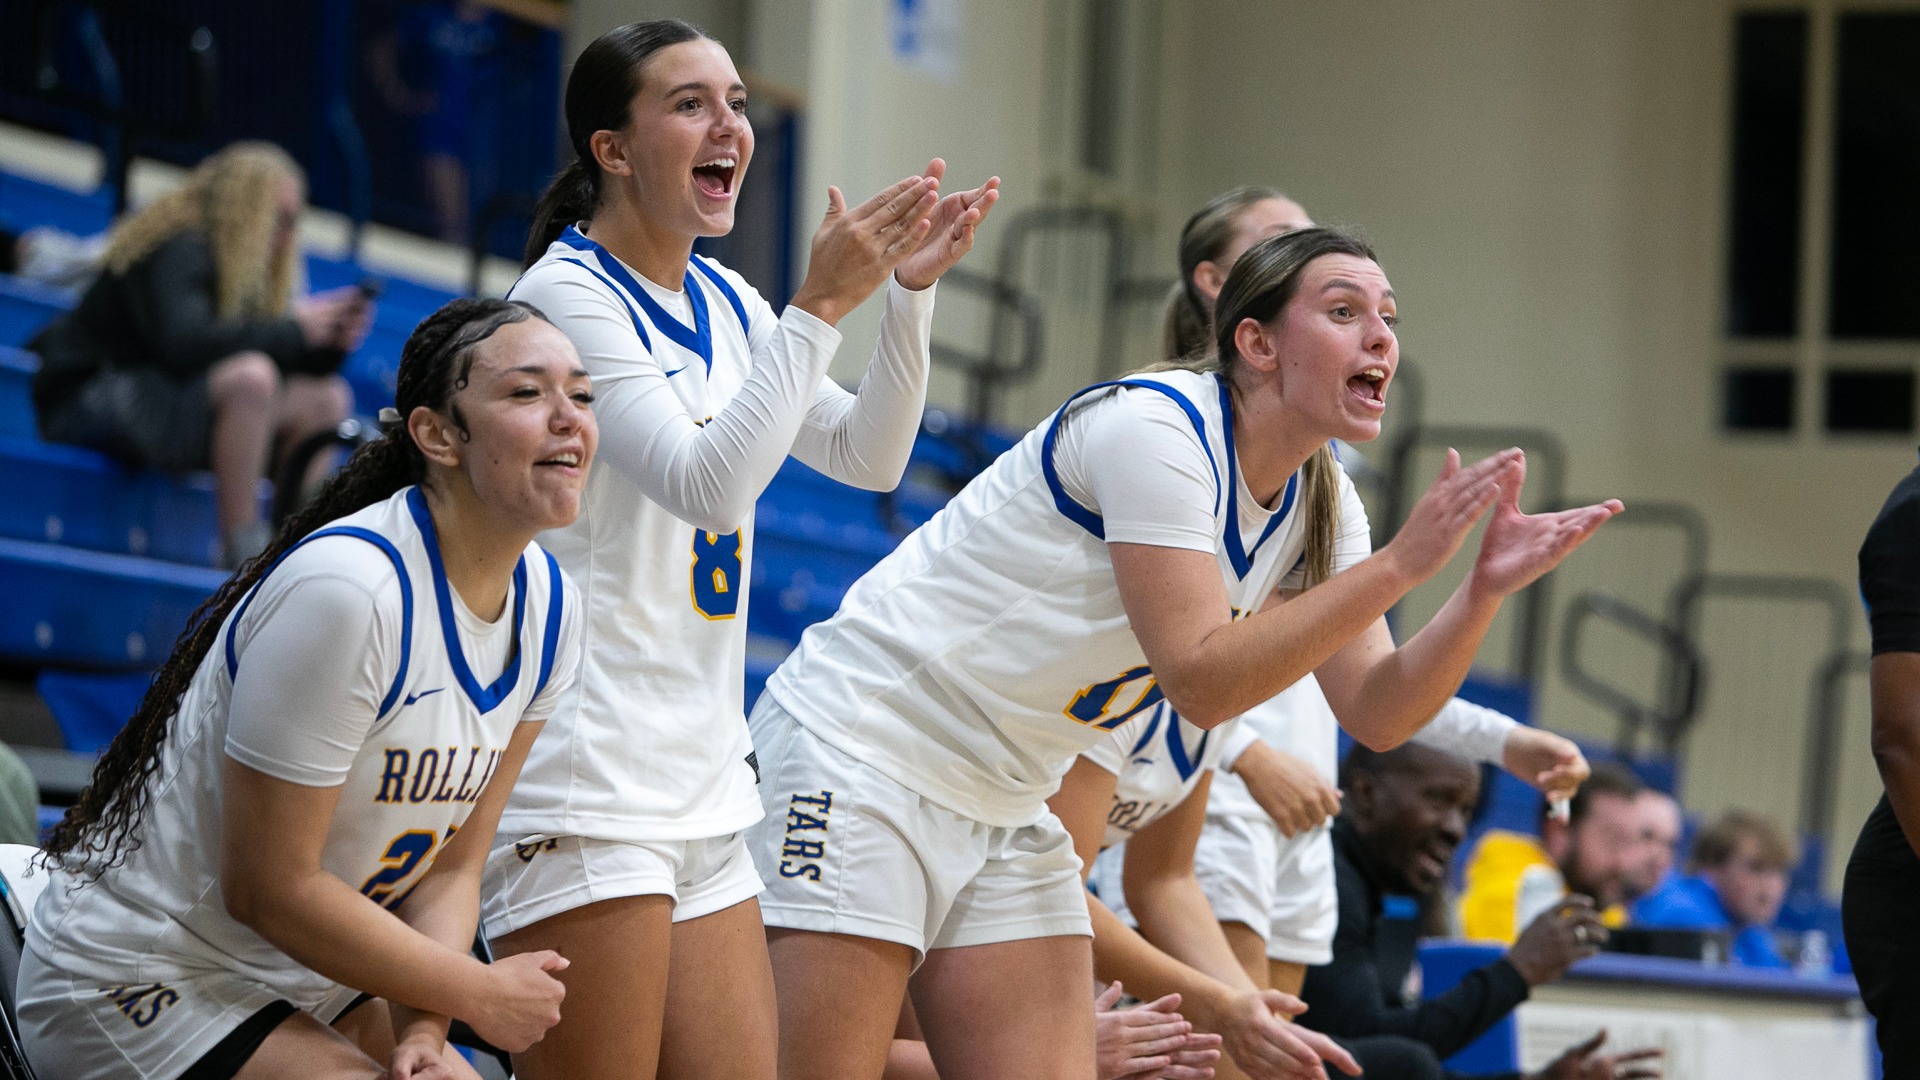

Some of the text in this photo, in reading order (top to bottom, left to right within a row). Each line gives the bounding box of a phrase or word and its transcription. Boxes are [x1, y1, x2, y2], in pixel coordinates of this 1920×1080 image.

[689, 524, 743, 621] 8
[374, 746, 506, 804] ROLLI
[358, 823, 461, 912] 2
[779, 789, 834, 882] TARS
